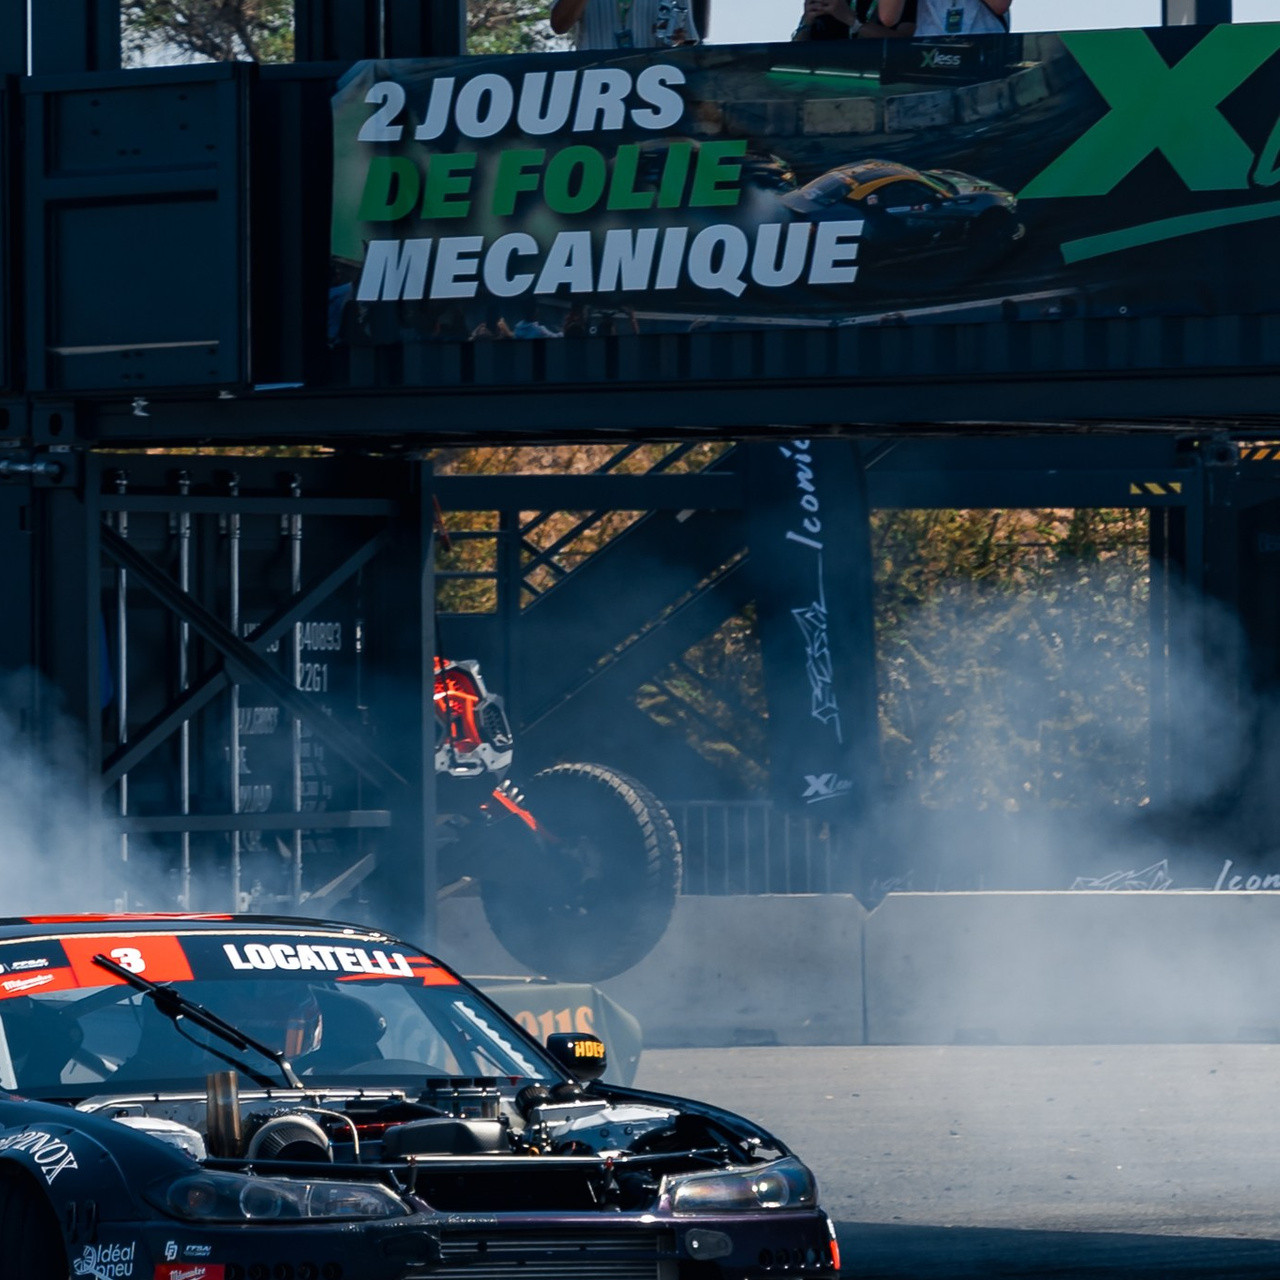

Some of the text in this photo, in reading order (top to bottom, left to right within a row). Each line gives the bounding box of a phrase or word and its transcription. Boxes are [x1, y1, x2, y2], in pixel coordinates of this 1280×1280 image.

[362, 64, 686, 142] 2 JOURS
[361, 139, 749, 221] DE FOLIE
[356, 219, 865, 302] MECANIQUE
[110, 947, 146, 974] 3
[223, 943, 416, 978] LOCATELLI
[97, 1241, 135, 1263] Idéal
